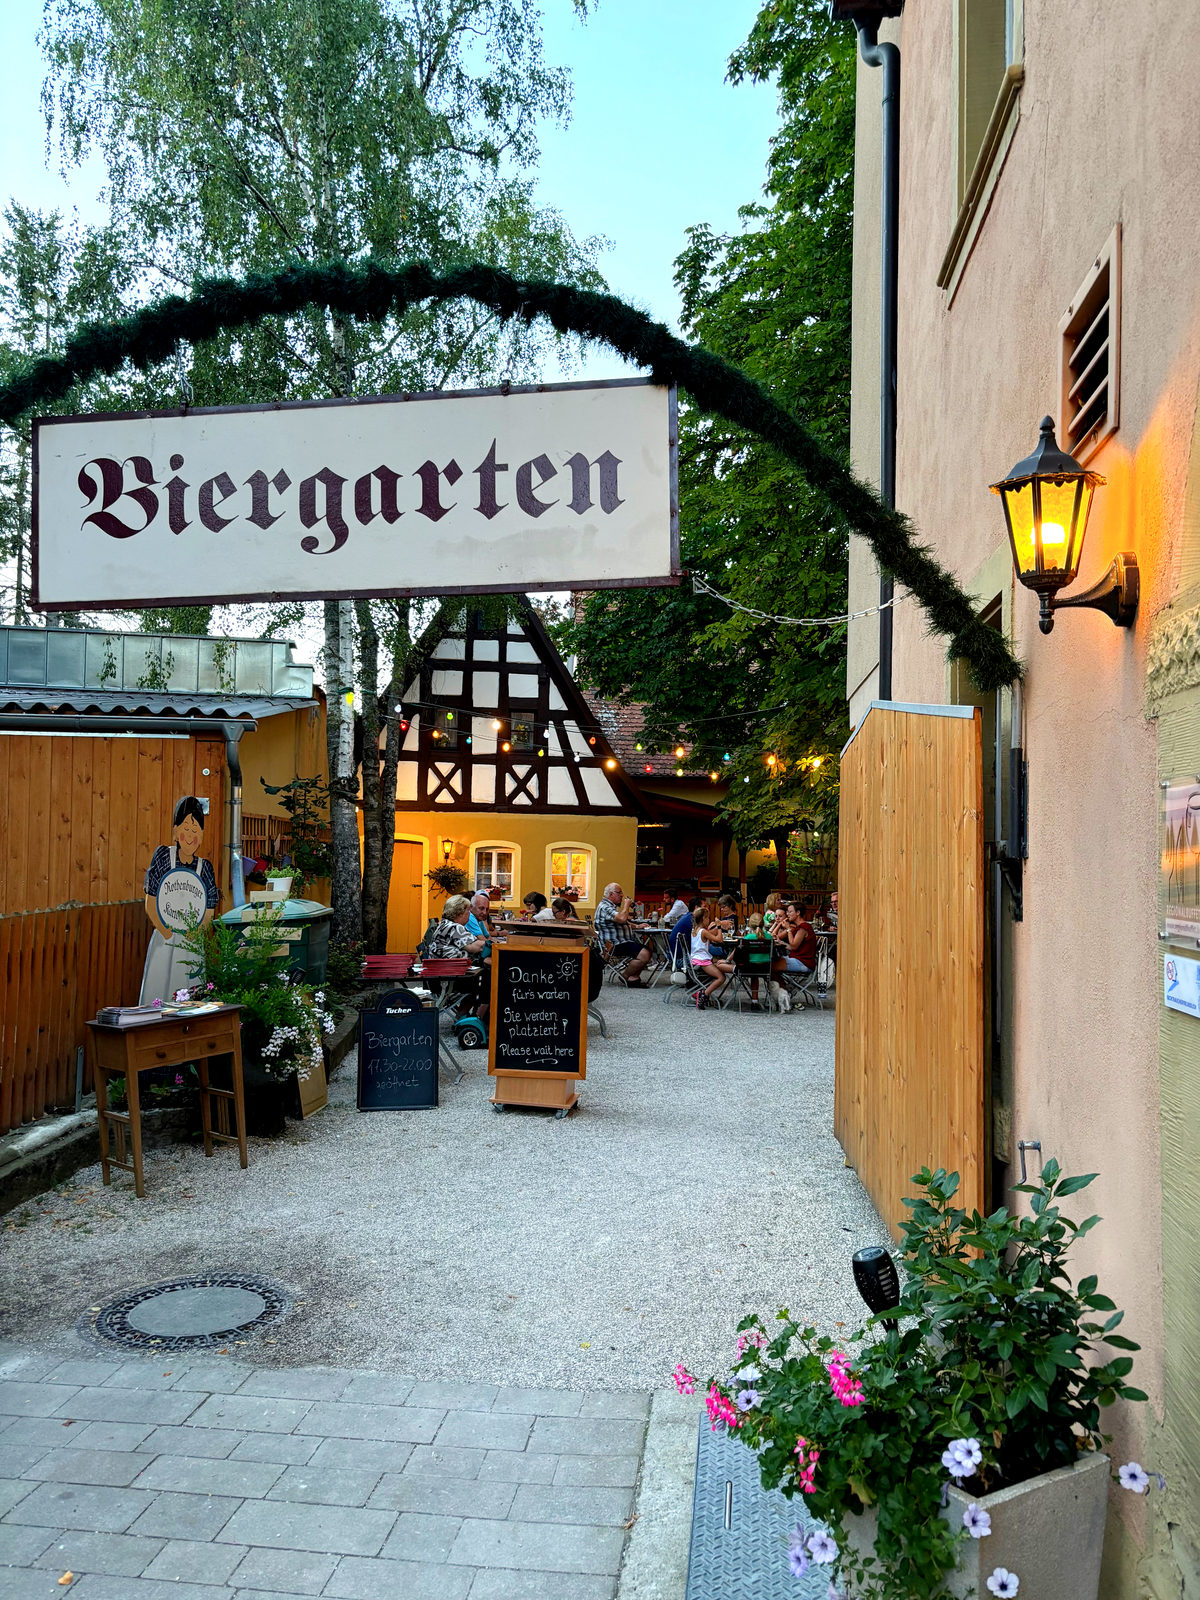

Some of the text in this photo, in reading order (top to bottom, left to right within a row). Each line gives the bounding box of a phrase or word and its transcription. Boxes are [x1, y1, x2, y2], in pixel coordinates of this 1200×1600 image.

[77, 438, 626, 555] Biergarten
[164, 879, 203, 899] Rothenburger
[508, 966, 555, 984] Danke
[386, 1007, 412, 1015] Tucher
[503, 1007, 558, 1023] Sie werden
[364, 1029, 433, 1056] Biergarten
[498, 1043, 576, 1057] Please wait here
